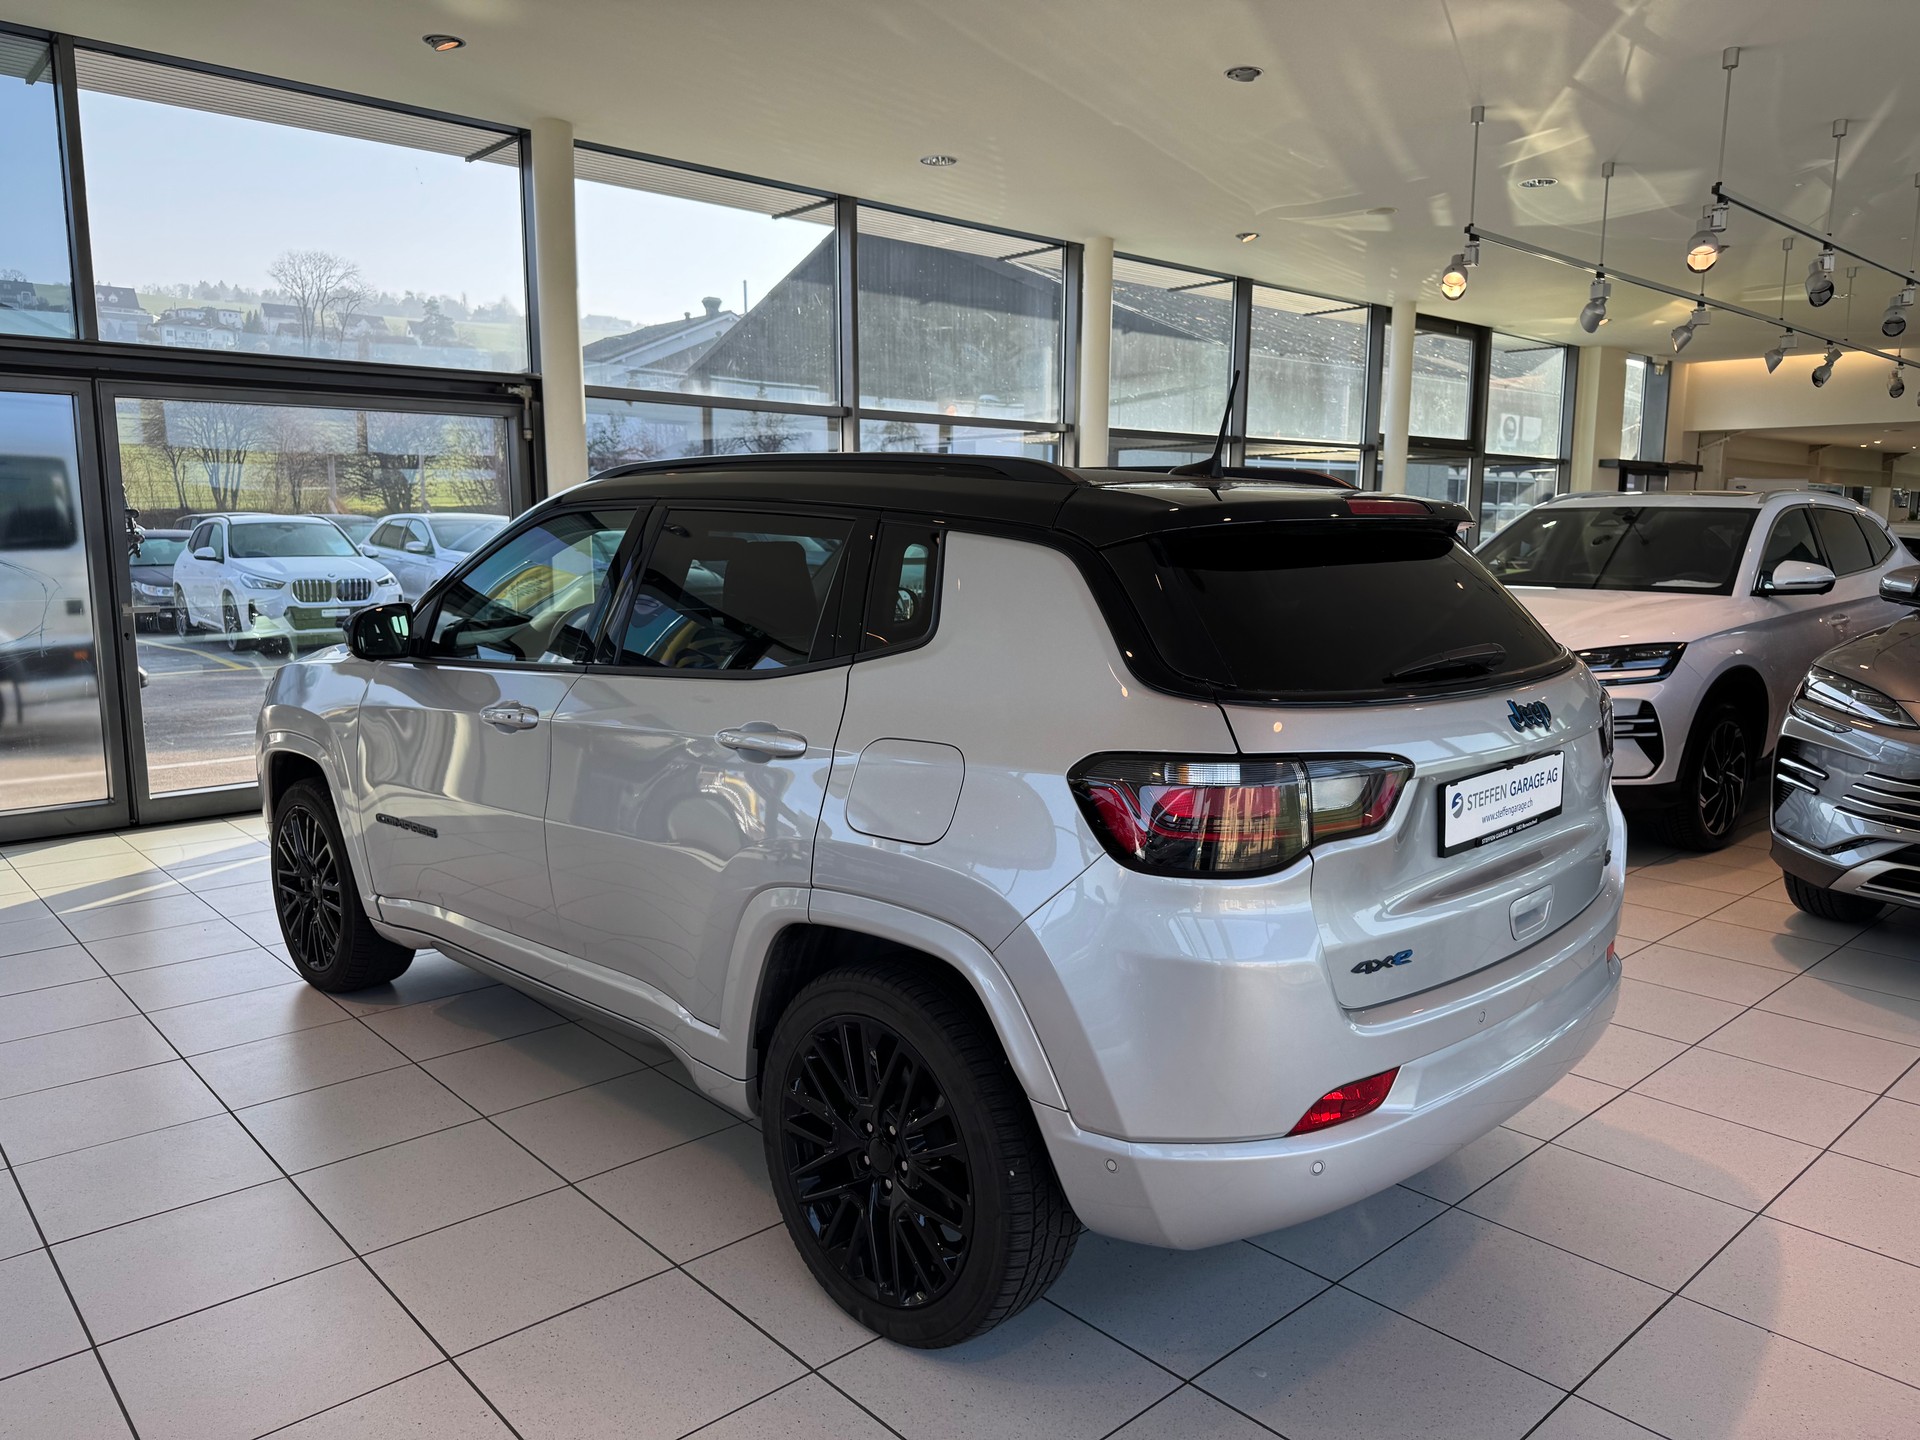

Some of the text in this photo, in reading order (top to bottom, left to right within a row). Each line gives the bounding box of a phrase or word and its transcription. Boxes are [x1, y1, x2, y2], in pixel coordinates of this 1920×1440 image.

[1506, 699, 1552, 733] Jeep
[1467, 767, 1558, 811] STEFFEN GARAGE AG
[1481, 798, 1534, 824] www.steffengarage.ch
